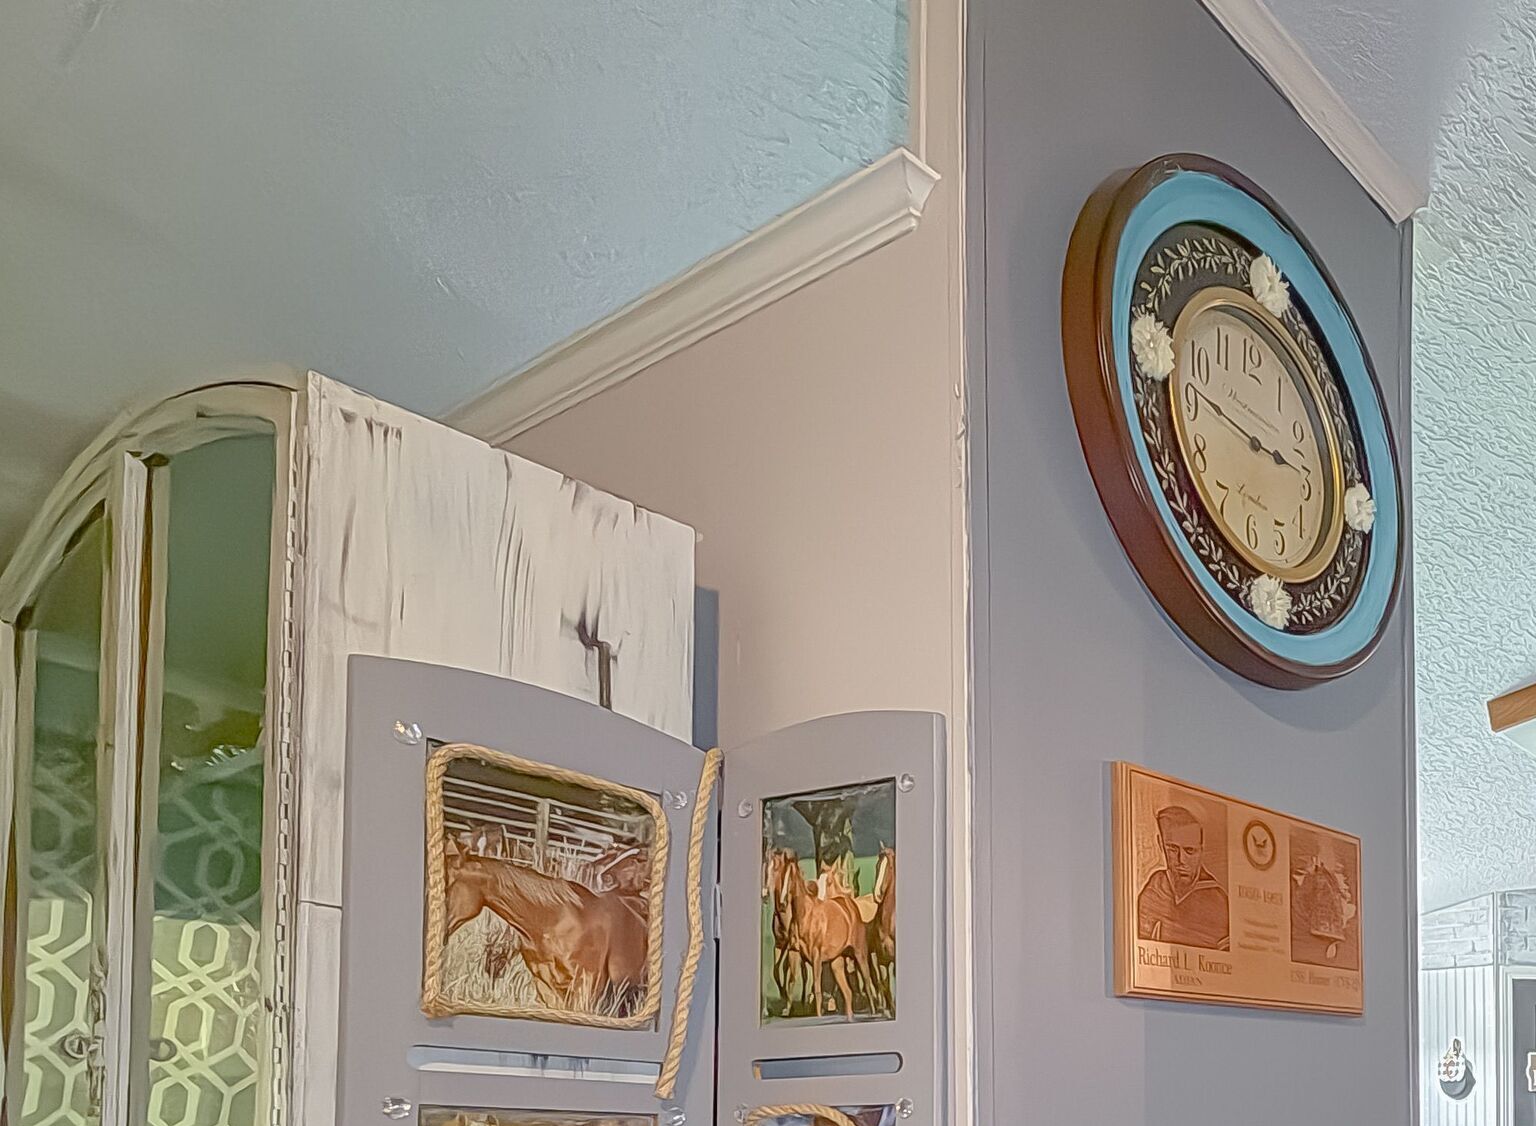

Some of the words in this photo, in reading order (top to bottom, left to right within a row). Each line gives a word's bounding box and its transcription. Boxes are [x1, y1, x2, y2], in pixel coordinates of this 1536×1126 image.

[1191, 340, 1210, 386] 10
[1216, 327, 1229, 371] 11
[1243, 337, 1262, 386] 12
[1185, 383, 1199, 421] 9
[1194, 433, 1207, 473] 8
[1215, 480, 1230, 521] 7
[1300, 464, 1312, 501] 3
[1246, 514, 1258, 549] 6
[1273, 518, 1285, 556] 5
[1137, 945, 1180, 969] Richard
